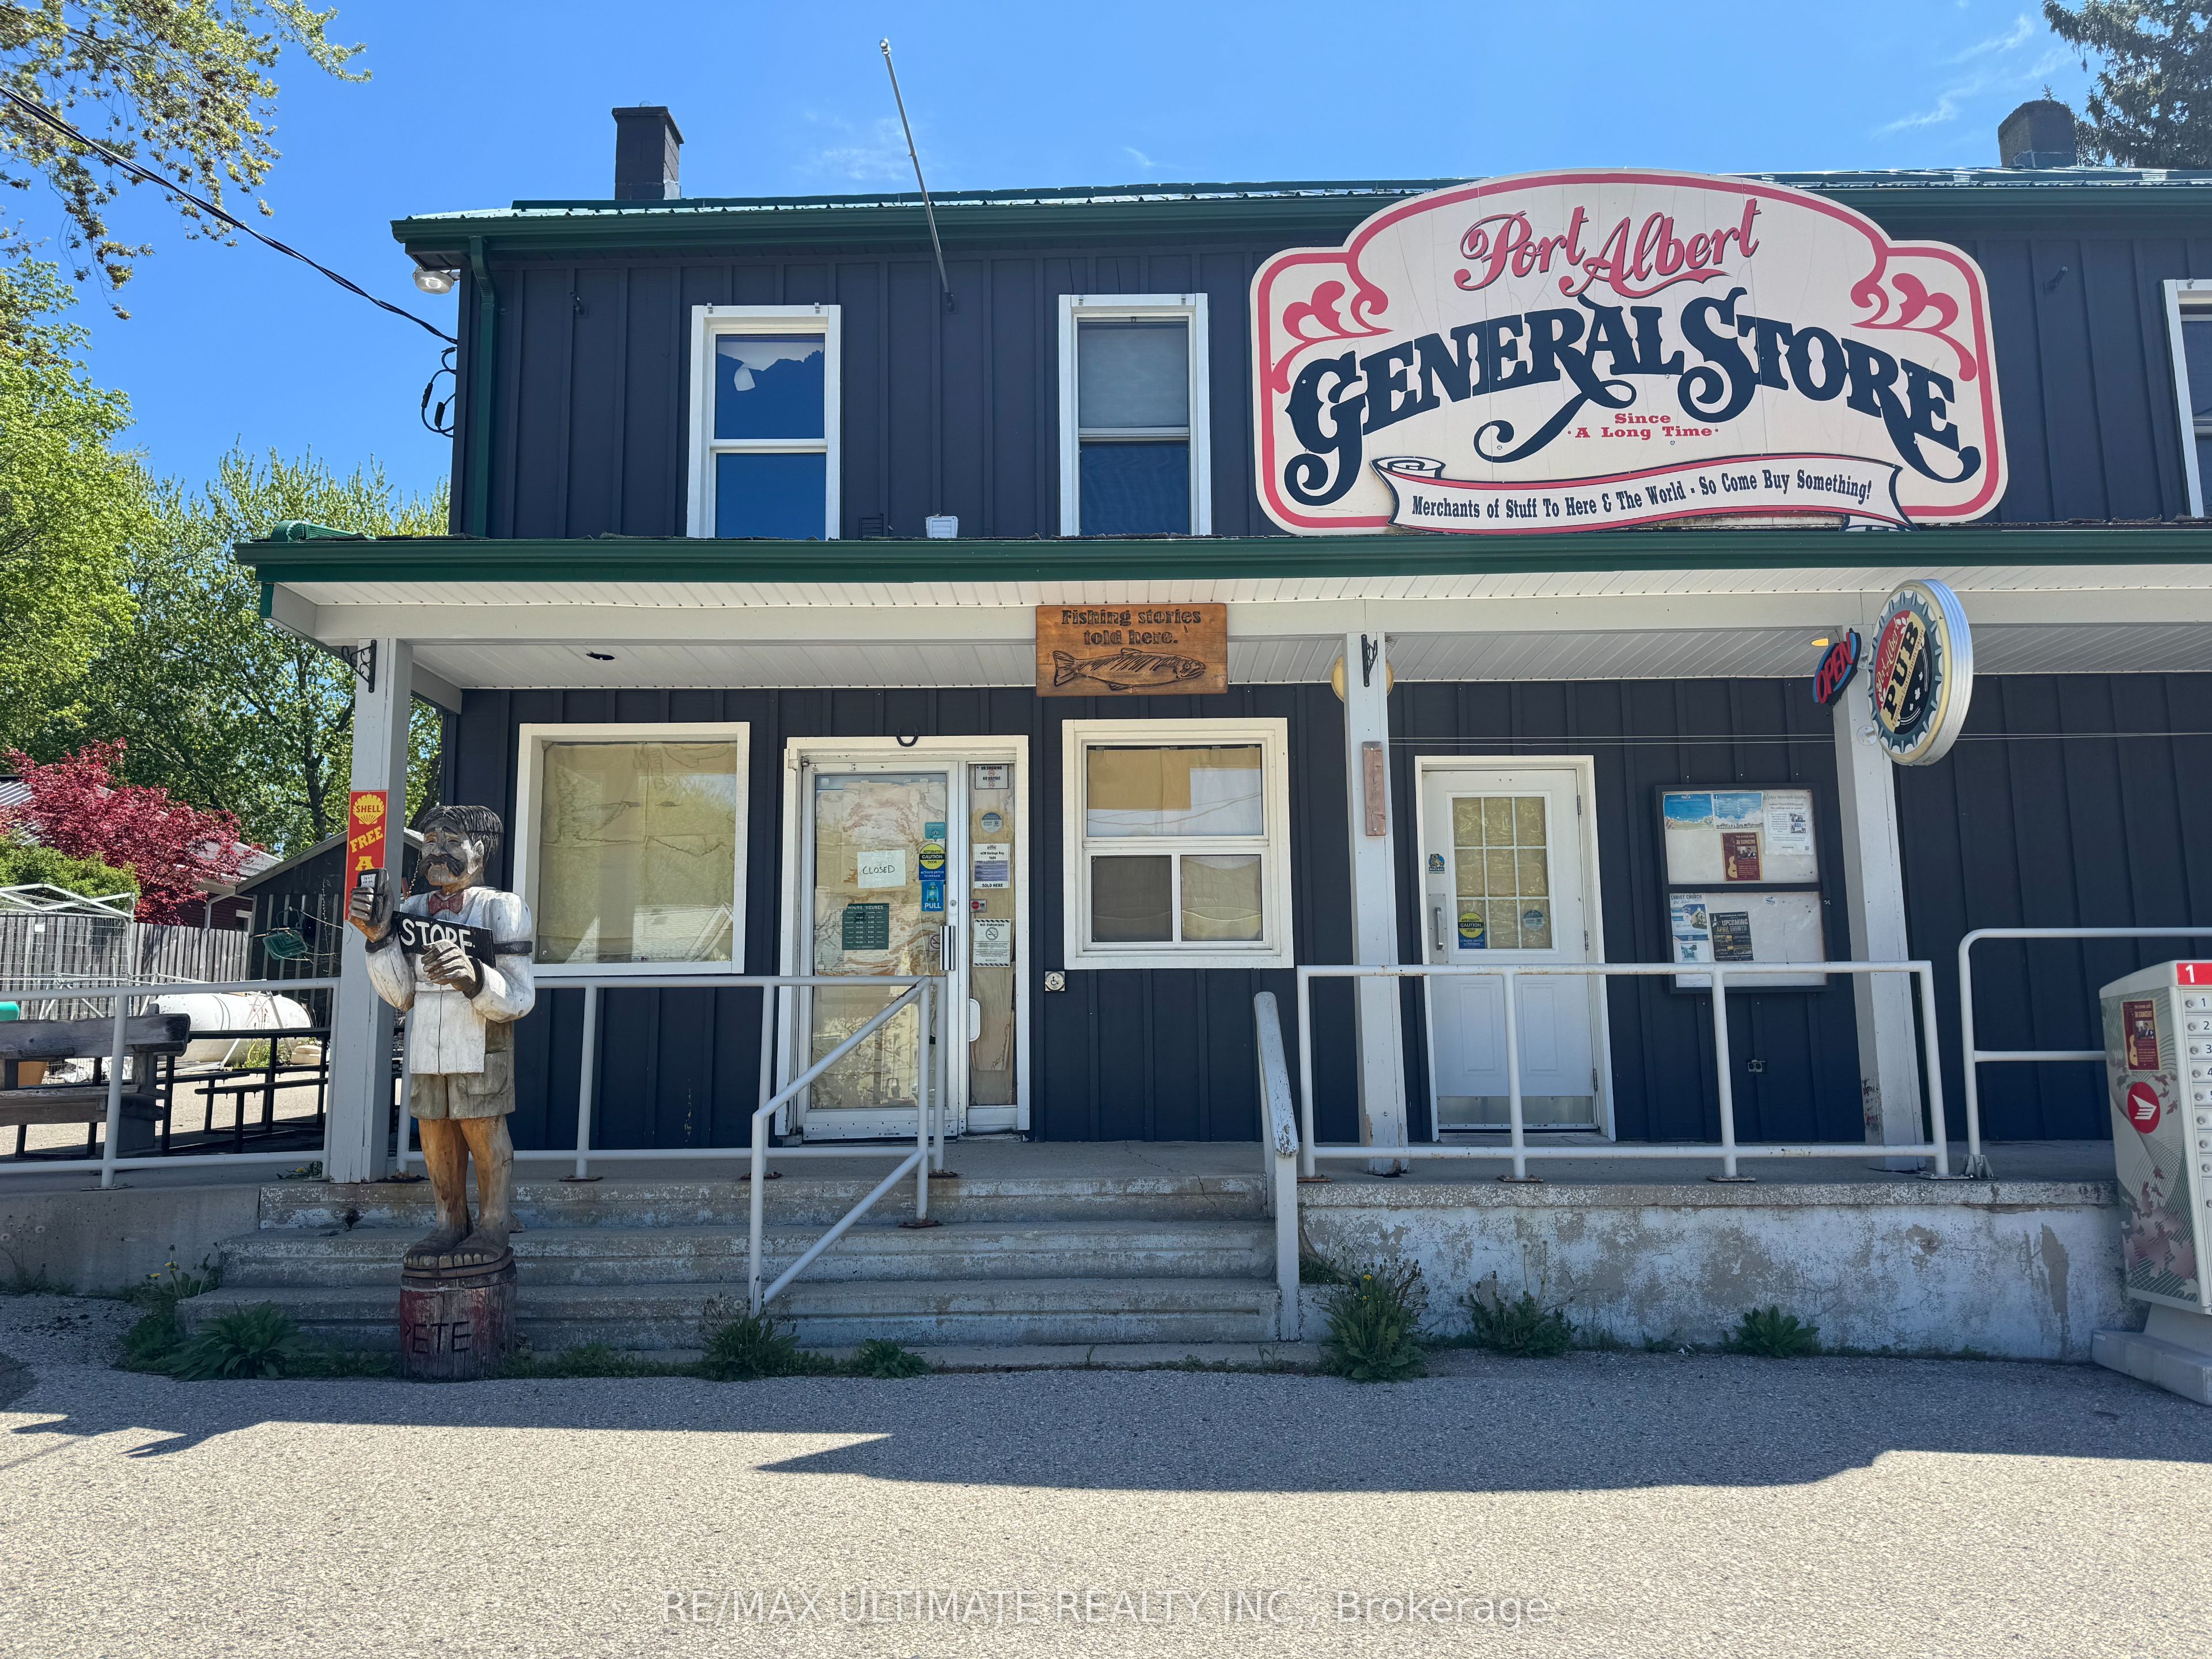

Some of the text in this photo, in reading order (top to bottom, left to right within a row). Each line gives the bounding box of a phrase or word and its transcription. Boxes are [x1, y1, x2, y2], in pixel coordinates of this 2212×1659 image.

[1453, 198, 1762, 299] Port Albert
[1284, 287, 1982, 506] GENERAL STORE
[1614, 412, 1671, 424] Since
[1575, 425, 1713, 441] A Long Time
[1412, 495, 1480, 518] Merchants
[1486, 498, 1499, 518] of
[1506, 497, 1538, 518] Stuff
[1543, 497, 1559, 518] To
[1565, 497, 1597, 516] Here
[1601, 493, 1612, 513] &
[1616, 490, 1642, 510] The
[1645, 480, 1686, 506] World
[1699, 475, 1717, 495] So
[1721, 472, 1758, 493] Come
[1762, 469, 1790, 494] Buy
[1797, 469, 1872, 505] Something!
[1061, 608, 1202, 626] Fishing stories
[1084, 629, 1179, 645] told here.
[1816, 631, 1854, 704] OPEN
[1883, 621, 1919, 721] PUB
[356, 805, 381, 813] SHELL
[350, 825, 384, 853] FREE
[862, 865, 895, 875] CLOSED
[1722, 918, 1748, 926] UPCOMING
[2185, 964, 2195, 983] 1
[2201, 998, 2206, 1007] 1
[2203, 1021, 2210, 1030] 2
[2206, 1044, 2212, 1054] 3
